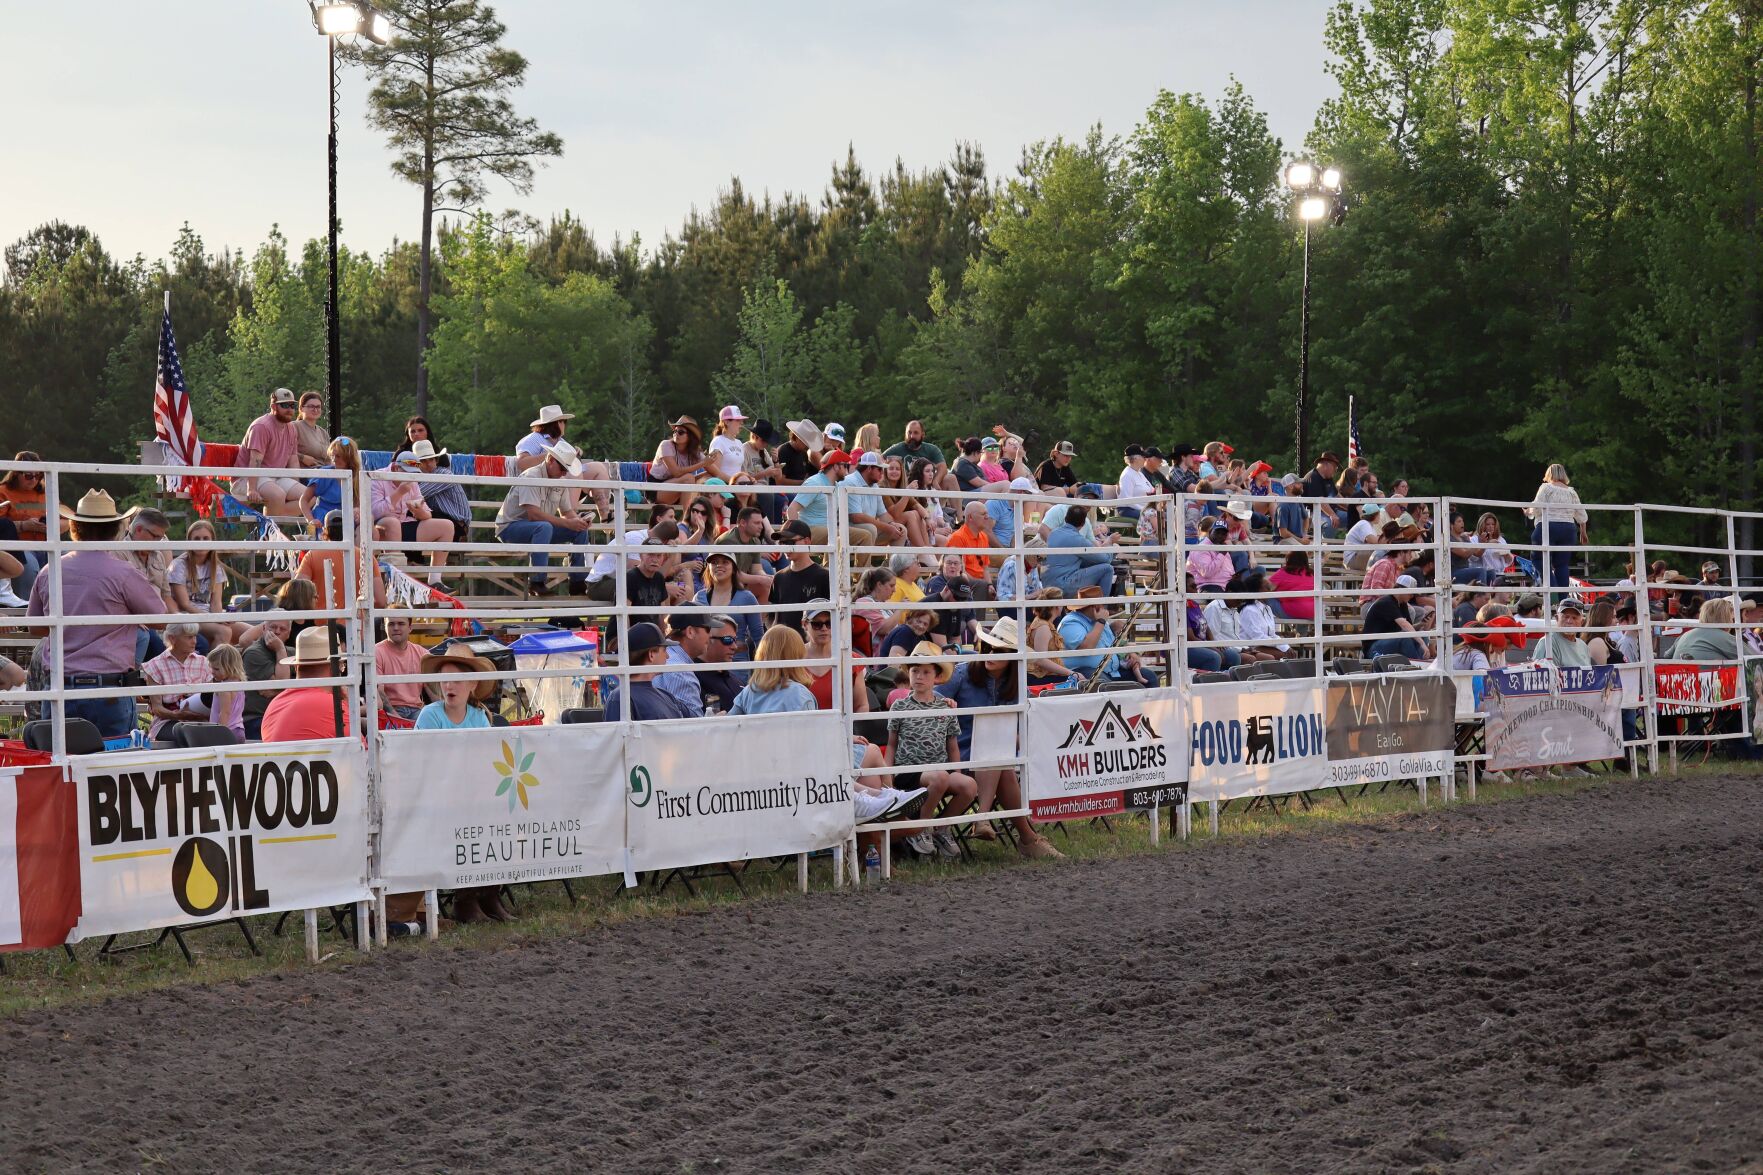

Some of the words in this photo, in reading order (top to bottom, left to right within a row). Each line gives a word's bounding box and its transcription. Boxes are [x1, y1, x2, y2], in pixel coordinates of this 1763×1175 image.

[1522, 671, 1568, 691] WELCE
[1571, 669, 1583, 689] TO
[1277, 713, 1322, 759] LION
[1056, 752, 1090, 779] KMH
[1094, 744, 1167, 775] BUILDERS
[1400, 757, 1446, 774] GoVaVia.c
[656, 789, 691, 820] First
[697, 781, 800, 817] Community
[805, 774, 850, 805] Bank
[1063, 780, 1082, 791] Custom
[1082, 779, 1099, 789] Home
[87, 760, 339, 845] BLYTHEWOOD
[1036, 797, 1118, 817] www.kmhbuilders.com
[455, 826, 484, 840] KEEP
[489, 824, 511, 837] THE
[517, 819, 581, 835] MIDLANDS
[456, 835, 582, 866] BEAUTIFUL
[172, 834, 269, 916] OIL
[456, 875, 473, 884] KEEP
[475, 872, 505, 883] AMERICA
[508, 868, 546, 881] BEAUTIFUL
[549, 864, 583, 875] AFFILIATE
